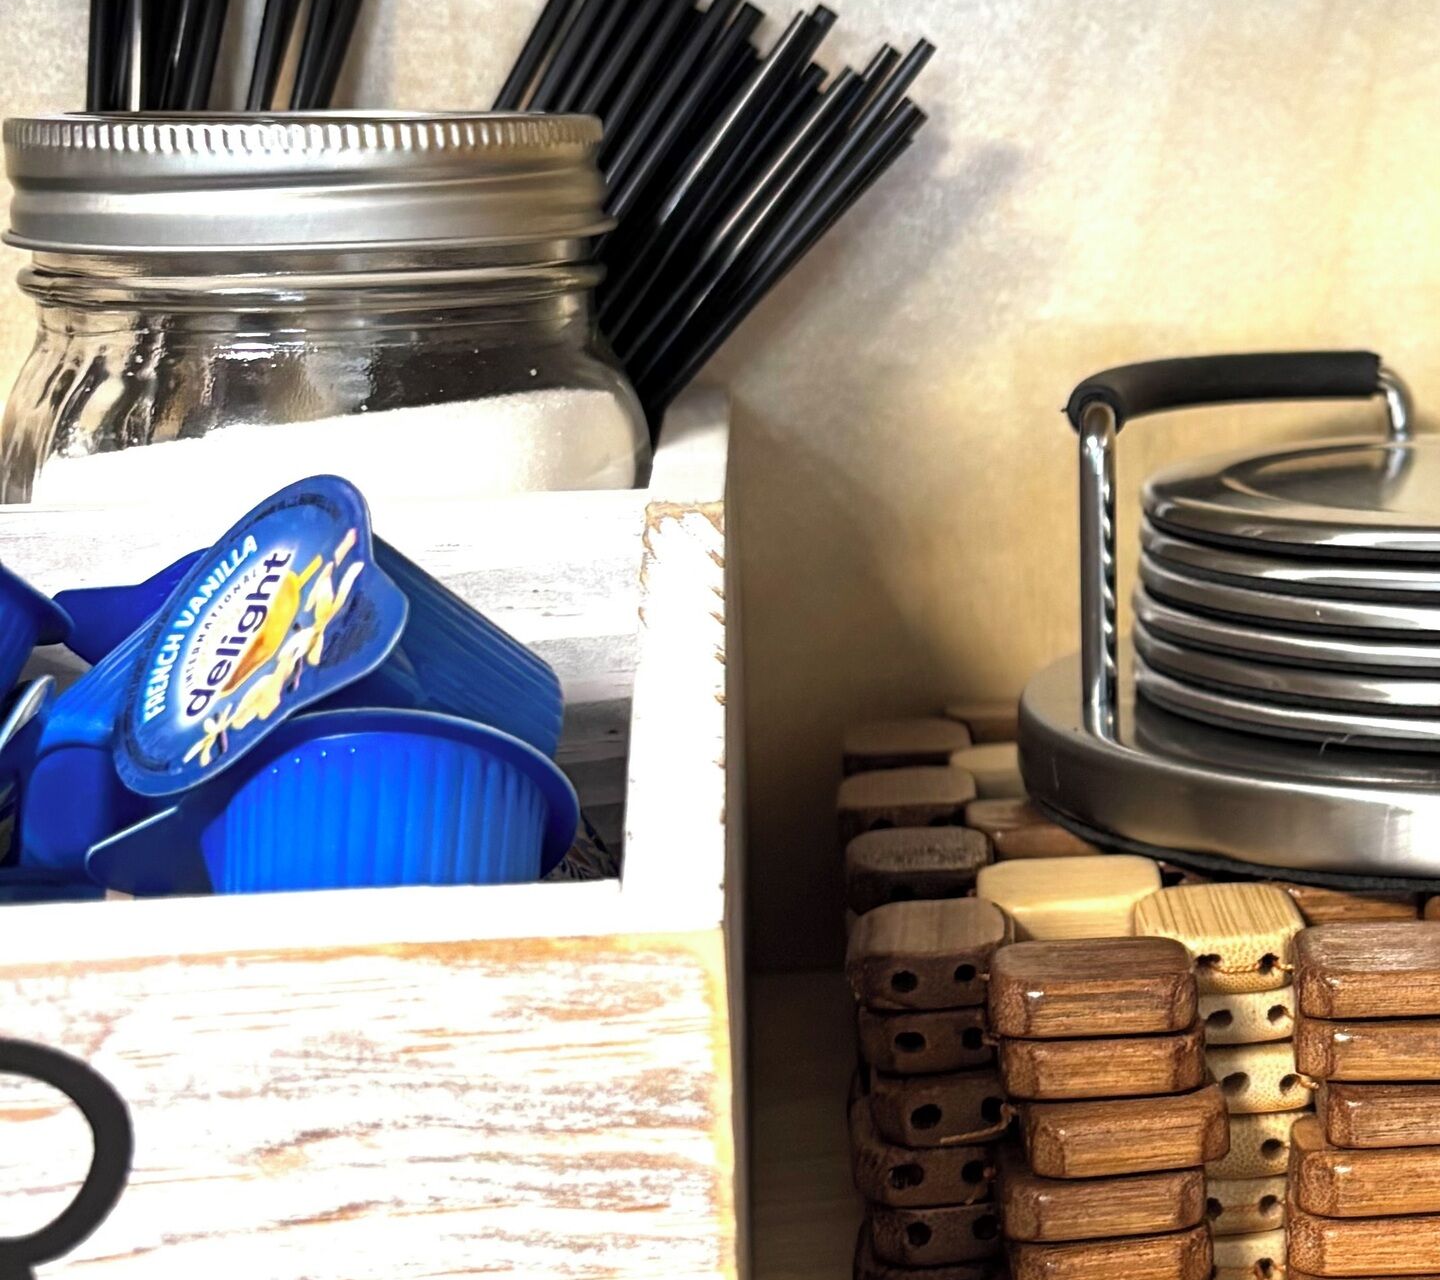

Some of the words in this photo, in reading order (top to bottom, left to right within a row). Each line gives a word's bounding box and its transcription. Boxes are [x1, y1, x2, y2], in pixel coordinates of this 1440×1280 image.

[143, 634, 185, 722] FRENCH
[174, 535, 258, 629] VANILLA
[186, 552, 291, 717] delight
